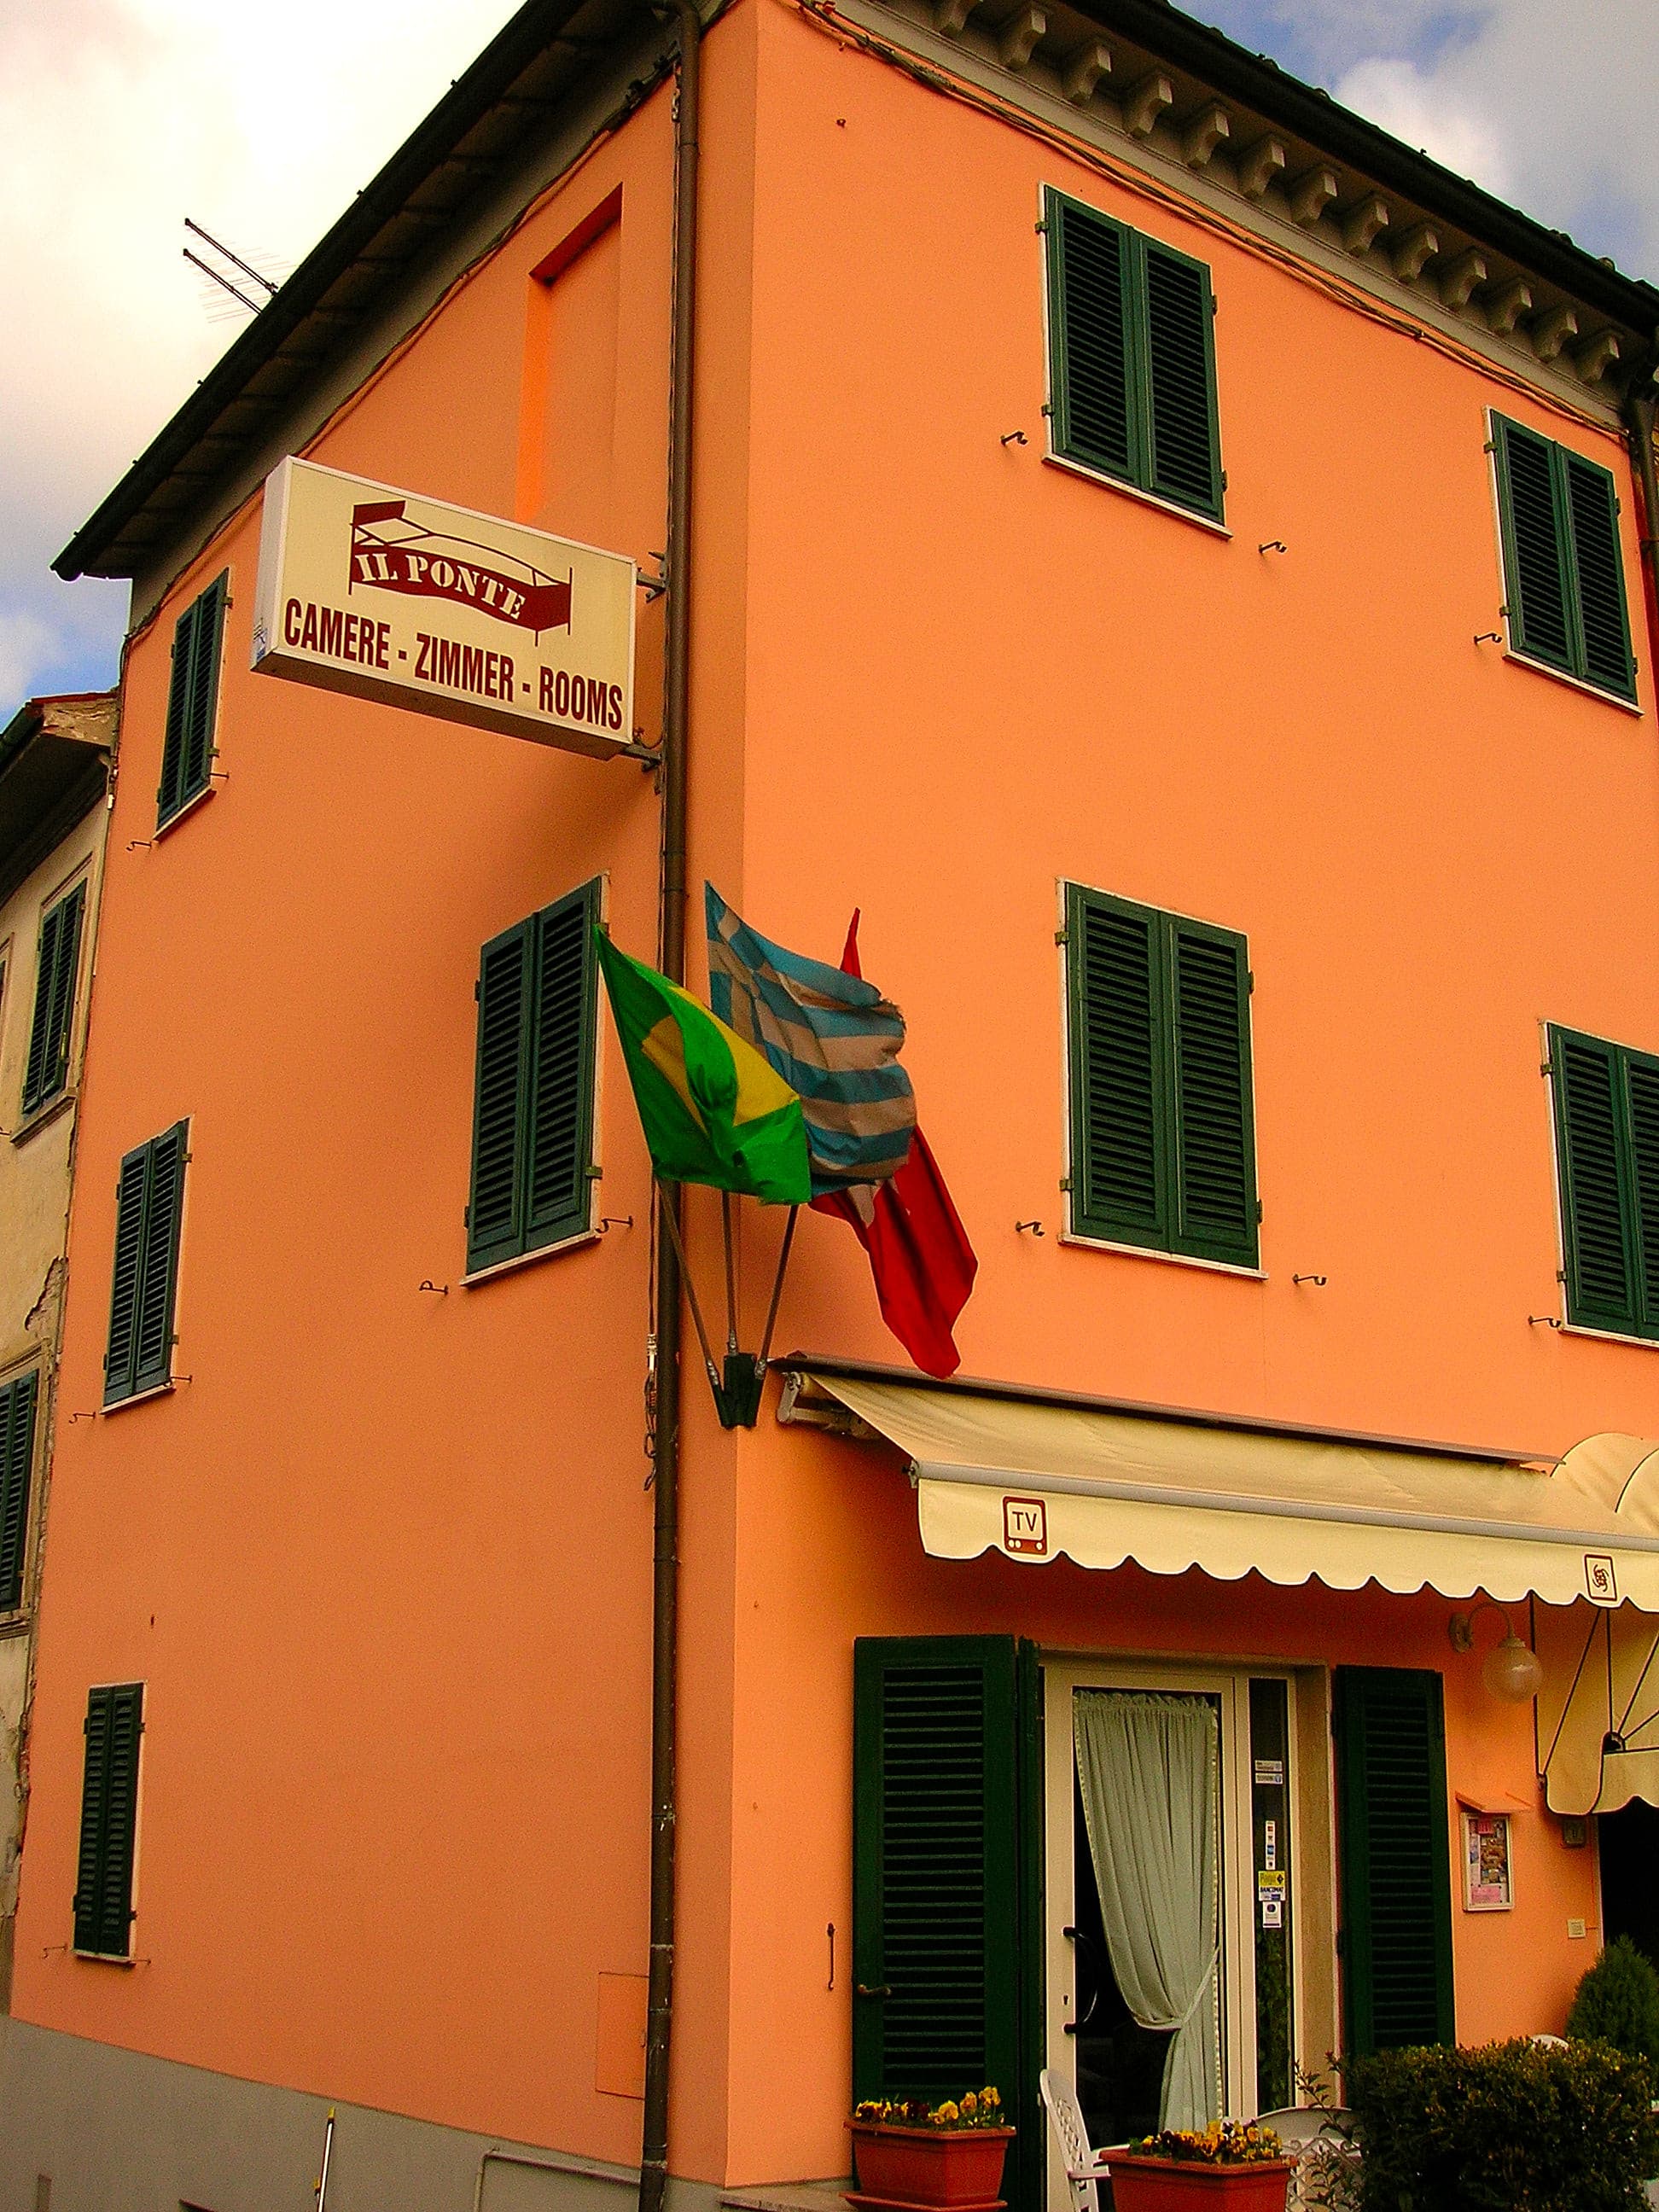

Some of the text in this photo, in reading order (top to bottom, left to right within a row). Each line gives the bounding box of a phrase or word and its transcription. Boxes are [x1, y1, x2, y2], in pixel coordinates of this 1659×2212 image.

[355, 553, 526, 620] IL PONTE
[284, 597, 391, 670] CAMERE
[415, 632, 514, 702] ZIMMER
[539, 666, 622, 731] ROOMS
[1012, 1511, 1037, 1532] TV
